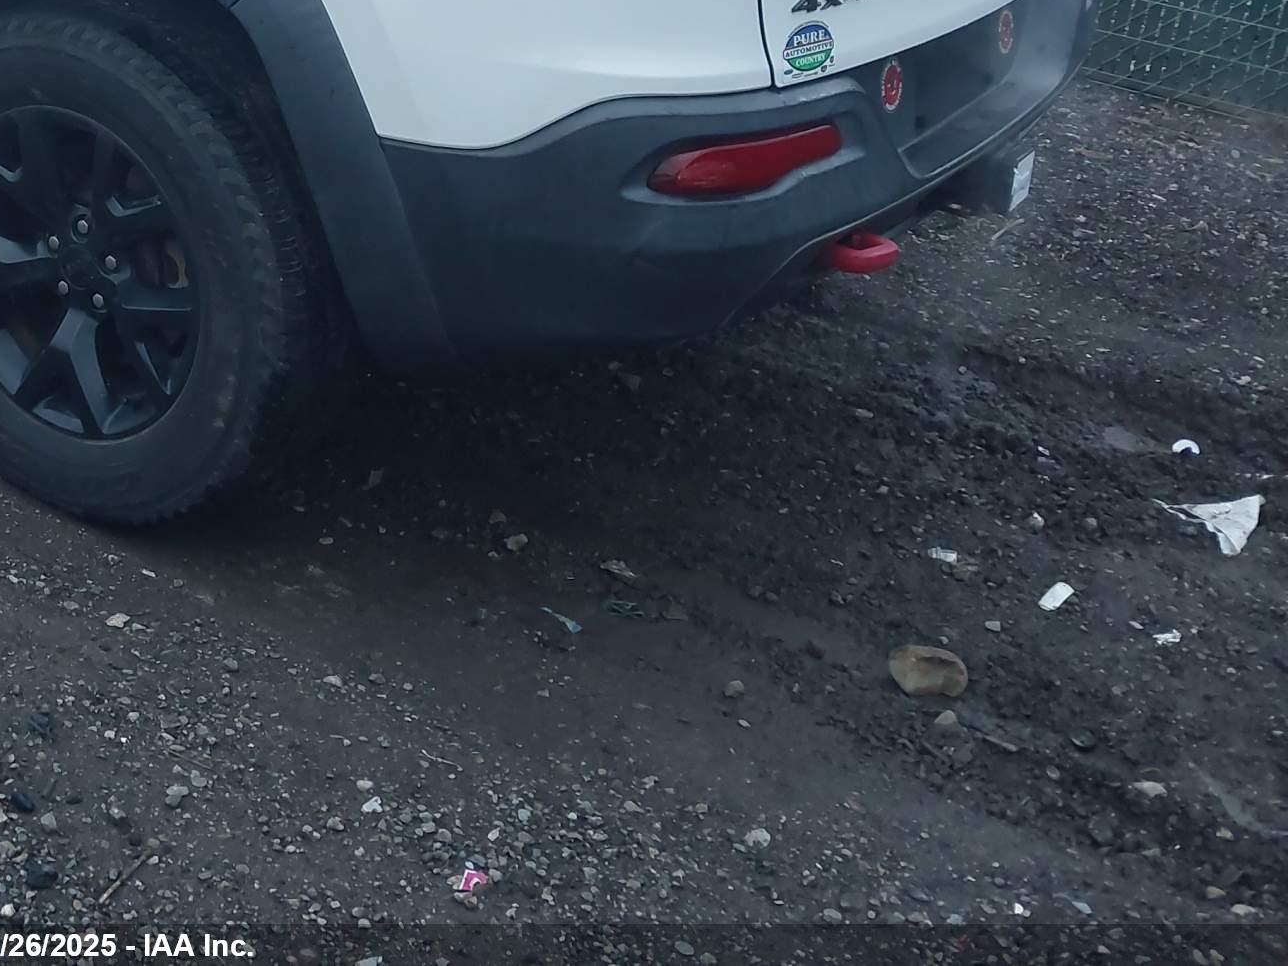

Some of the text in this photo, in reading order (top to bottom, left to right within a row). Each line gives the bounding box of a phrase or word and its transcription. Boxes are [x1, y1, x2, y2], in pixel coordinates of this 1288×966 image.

[793, 29, 826, 47] PURE
[785, 42, 833, 58] AUTOMOTIVE
[795, 52, 826, 67] COUNTRY
